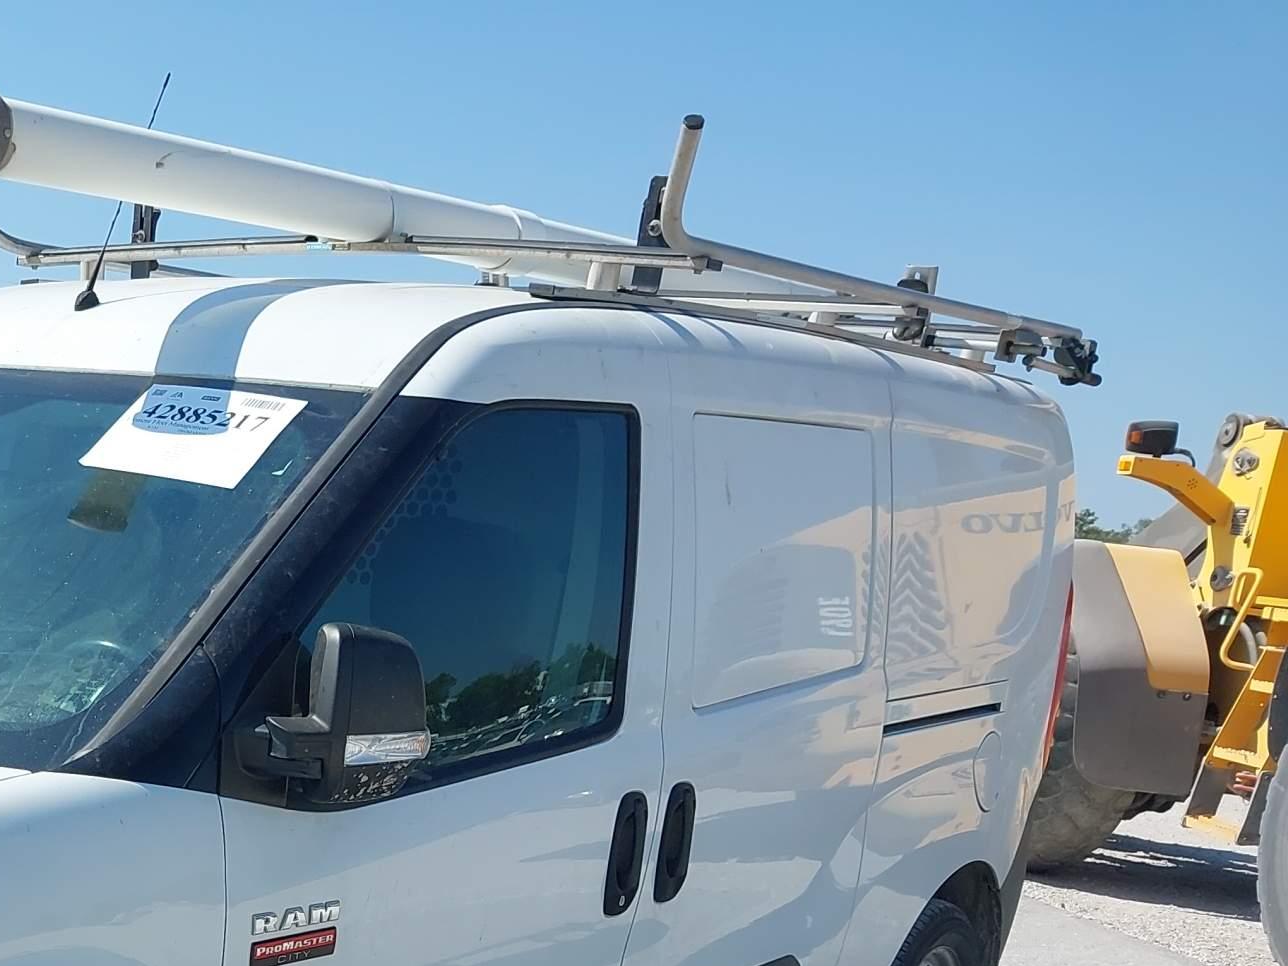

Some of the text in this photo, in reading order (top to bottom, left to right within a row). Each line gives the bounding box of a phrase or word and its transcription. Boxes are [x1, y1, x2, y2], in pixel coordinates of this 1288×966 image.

[142, 402, 272, 433] 42885217
[251, 899, 340, 936] RAM
[277, 950, 311, 964] CITY
